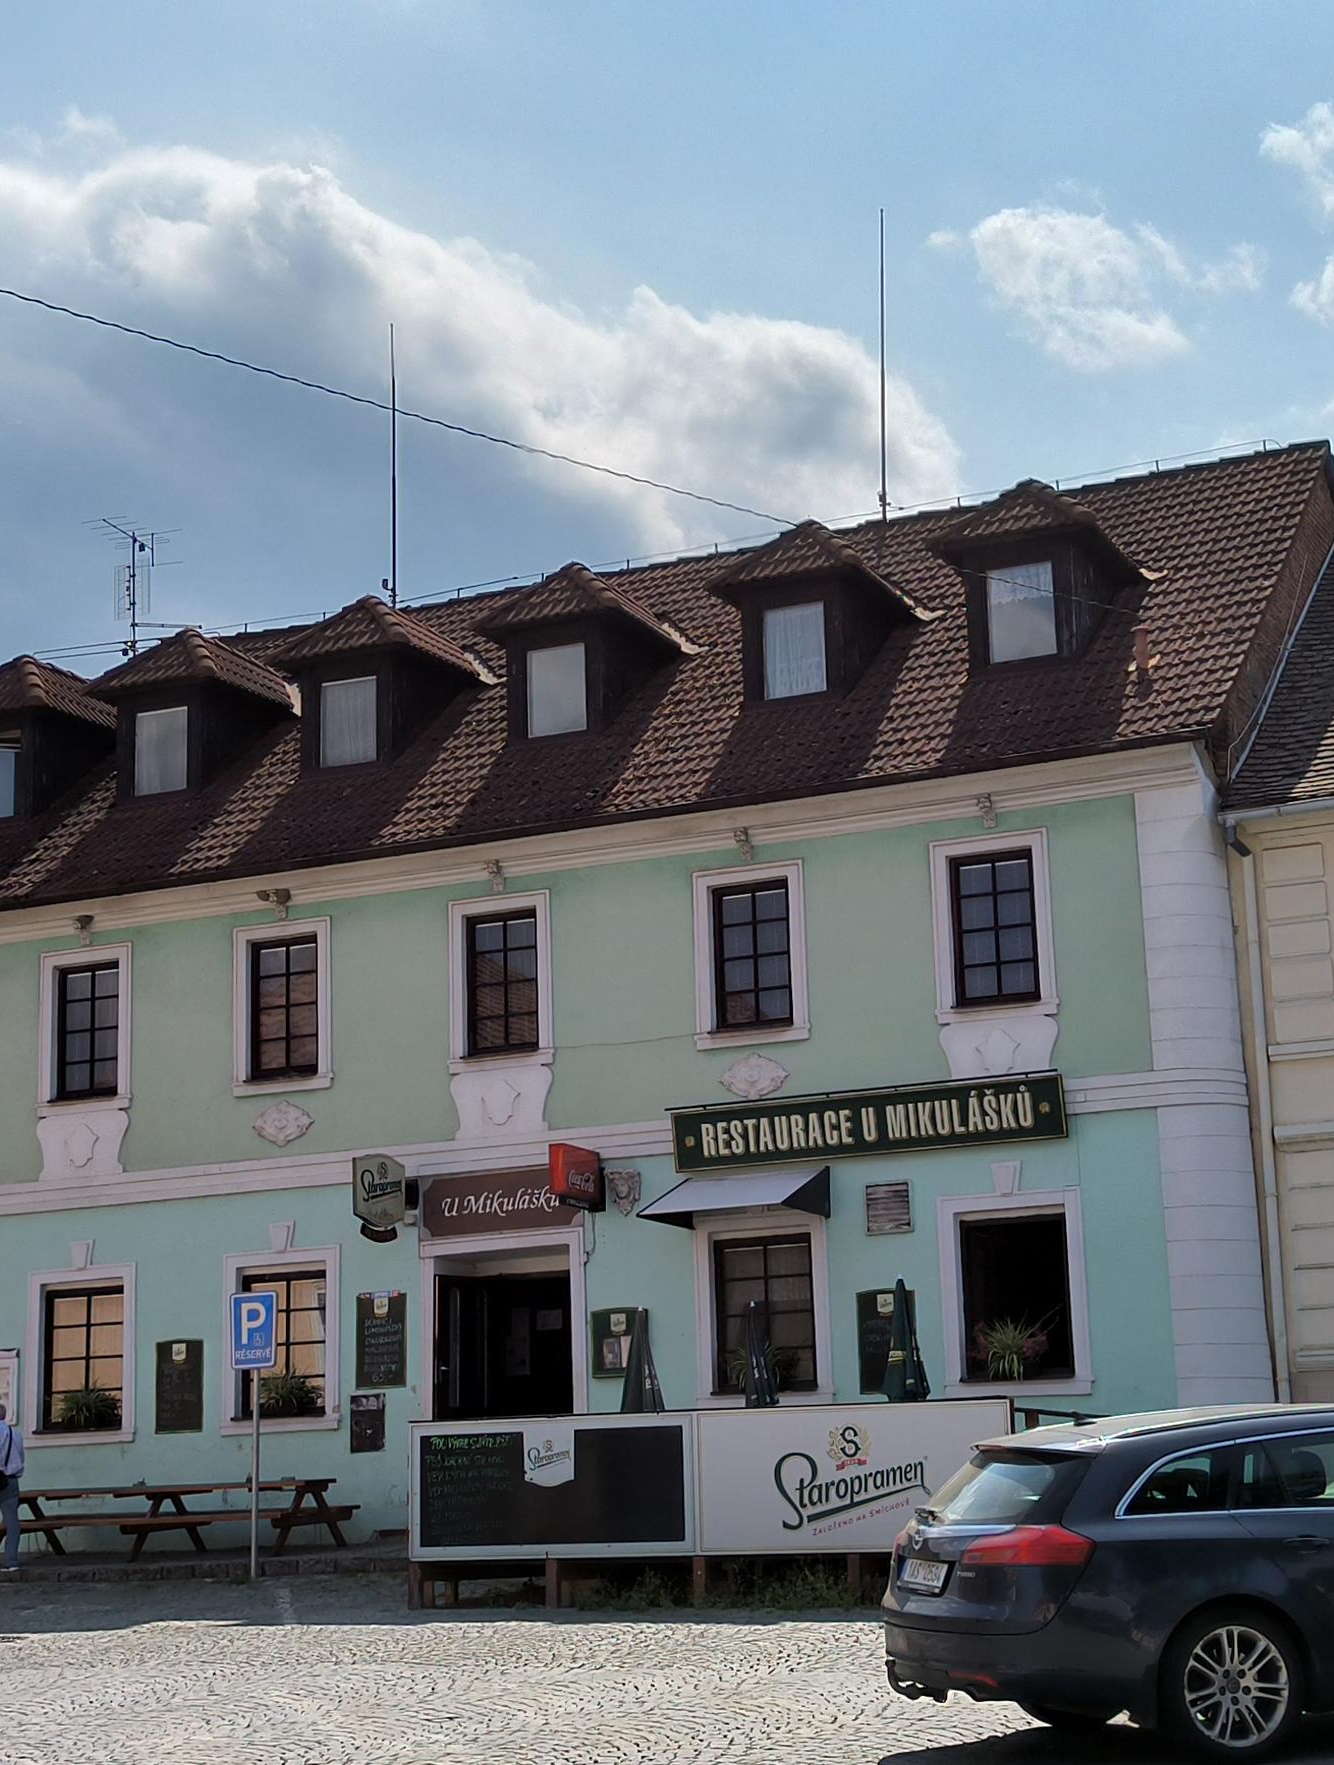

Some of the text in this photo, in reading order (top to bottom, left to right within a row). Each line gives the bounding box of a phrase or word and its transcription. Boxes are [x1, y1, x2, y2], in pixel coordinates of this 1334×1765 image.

[700, 1084, 1035, 1159] RESTAURACE U MIKULÁŠKŮ
[441, 1198, 460, 1217] U
[241, 1302, 266, 1345] P
[774, 1452, 931, 1530] Staropramen
